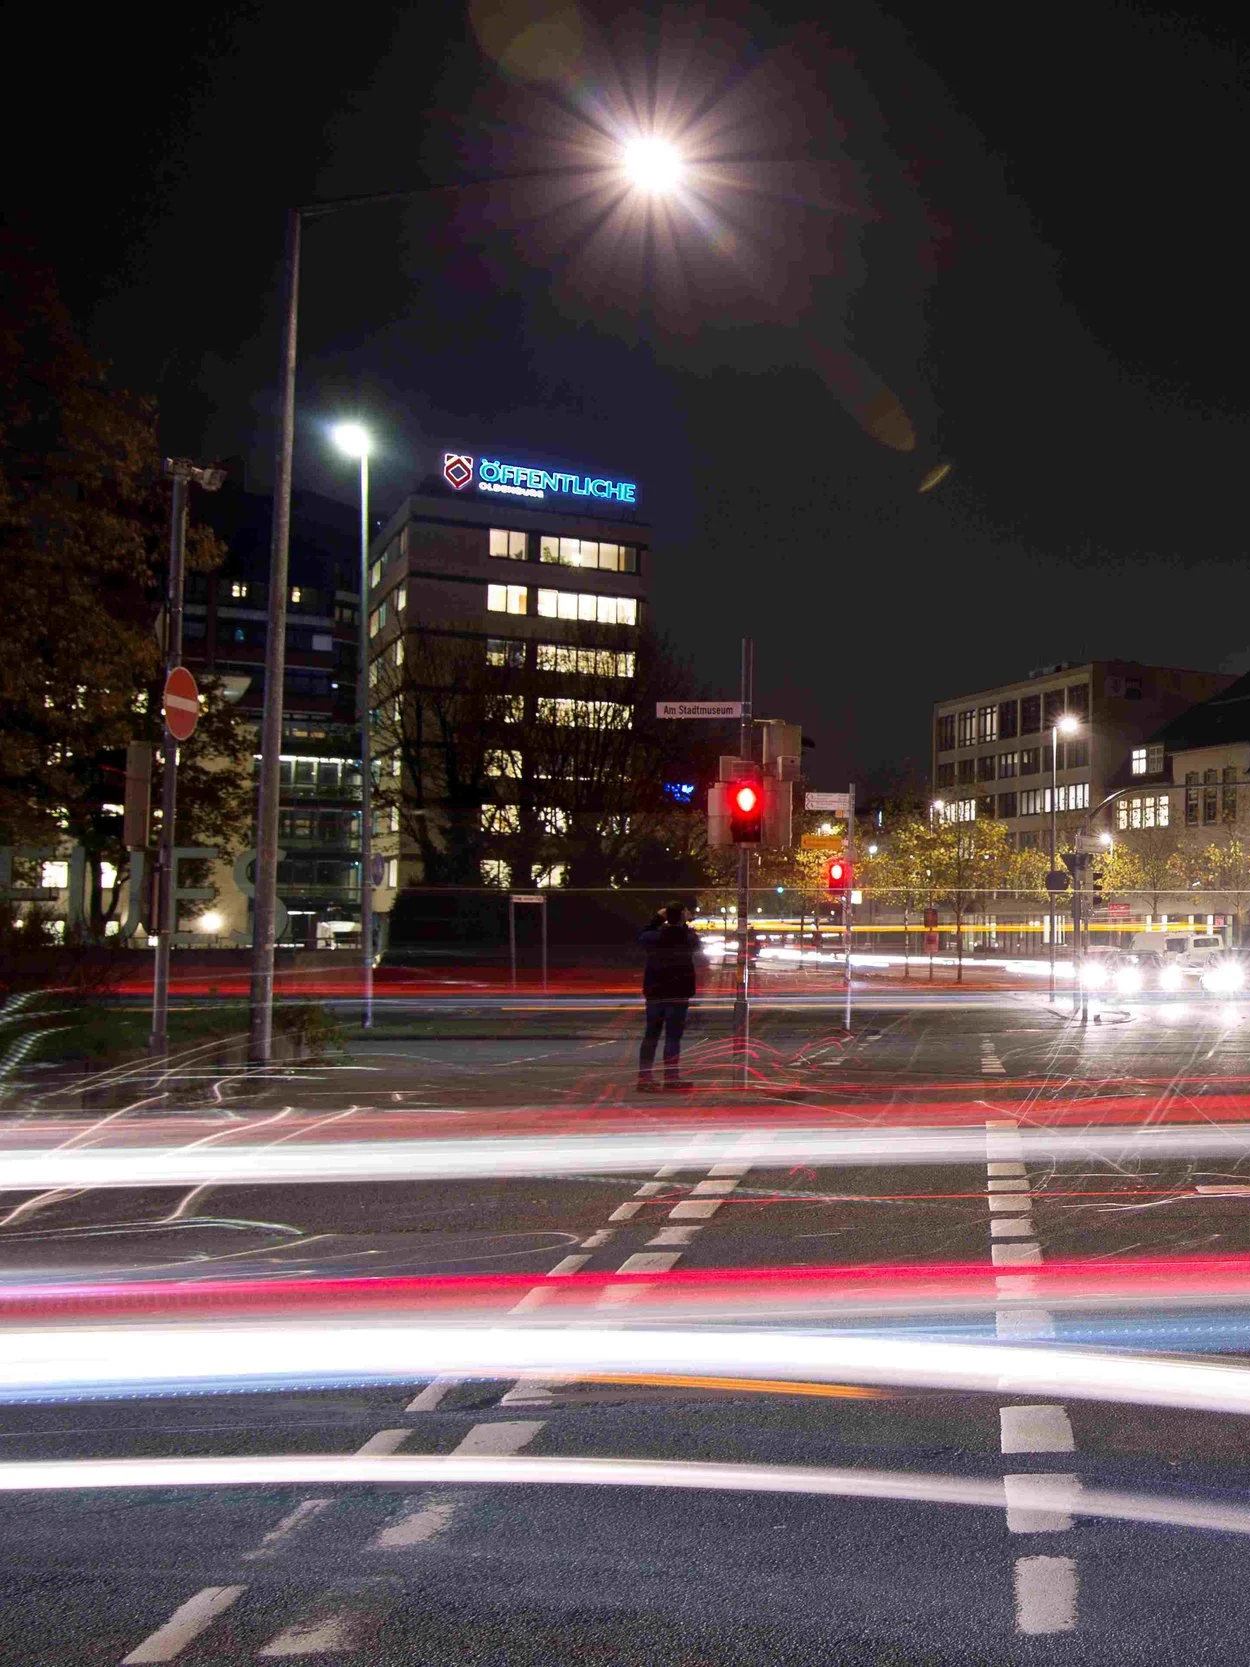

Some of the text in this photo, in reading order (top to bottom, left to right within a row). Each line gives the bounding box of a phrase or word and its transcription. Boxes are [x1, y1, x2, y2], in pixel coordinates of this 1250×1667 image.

[479, 458, 636, 503] ÖFFENTLICHE
[663, 704, 734, 715] Am Stadtmuseum
